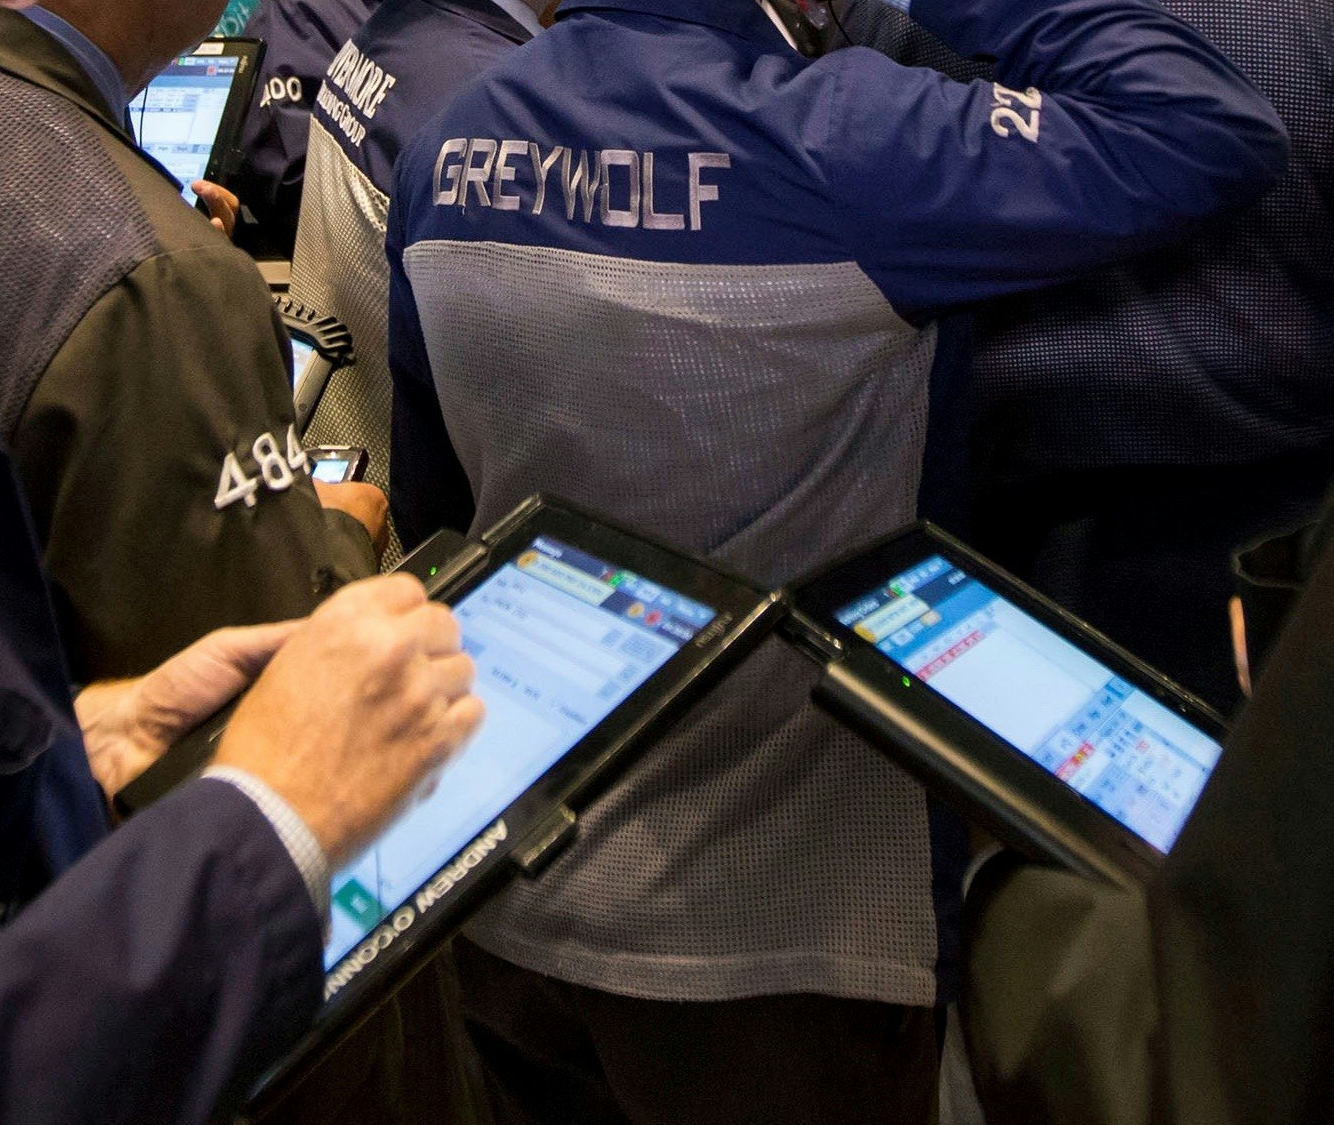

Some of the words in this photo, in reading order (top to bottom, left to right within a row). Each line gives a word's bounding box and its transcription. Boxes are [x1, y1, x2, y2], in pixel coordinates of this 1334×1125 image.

[433, 138, 731, 232] GREYWOLF
[214, 423, 312, 509] 484
[417, 818, 508, 913] ANDREW
[323, 906, 415, 1002] O'CONN
